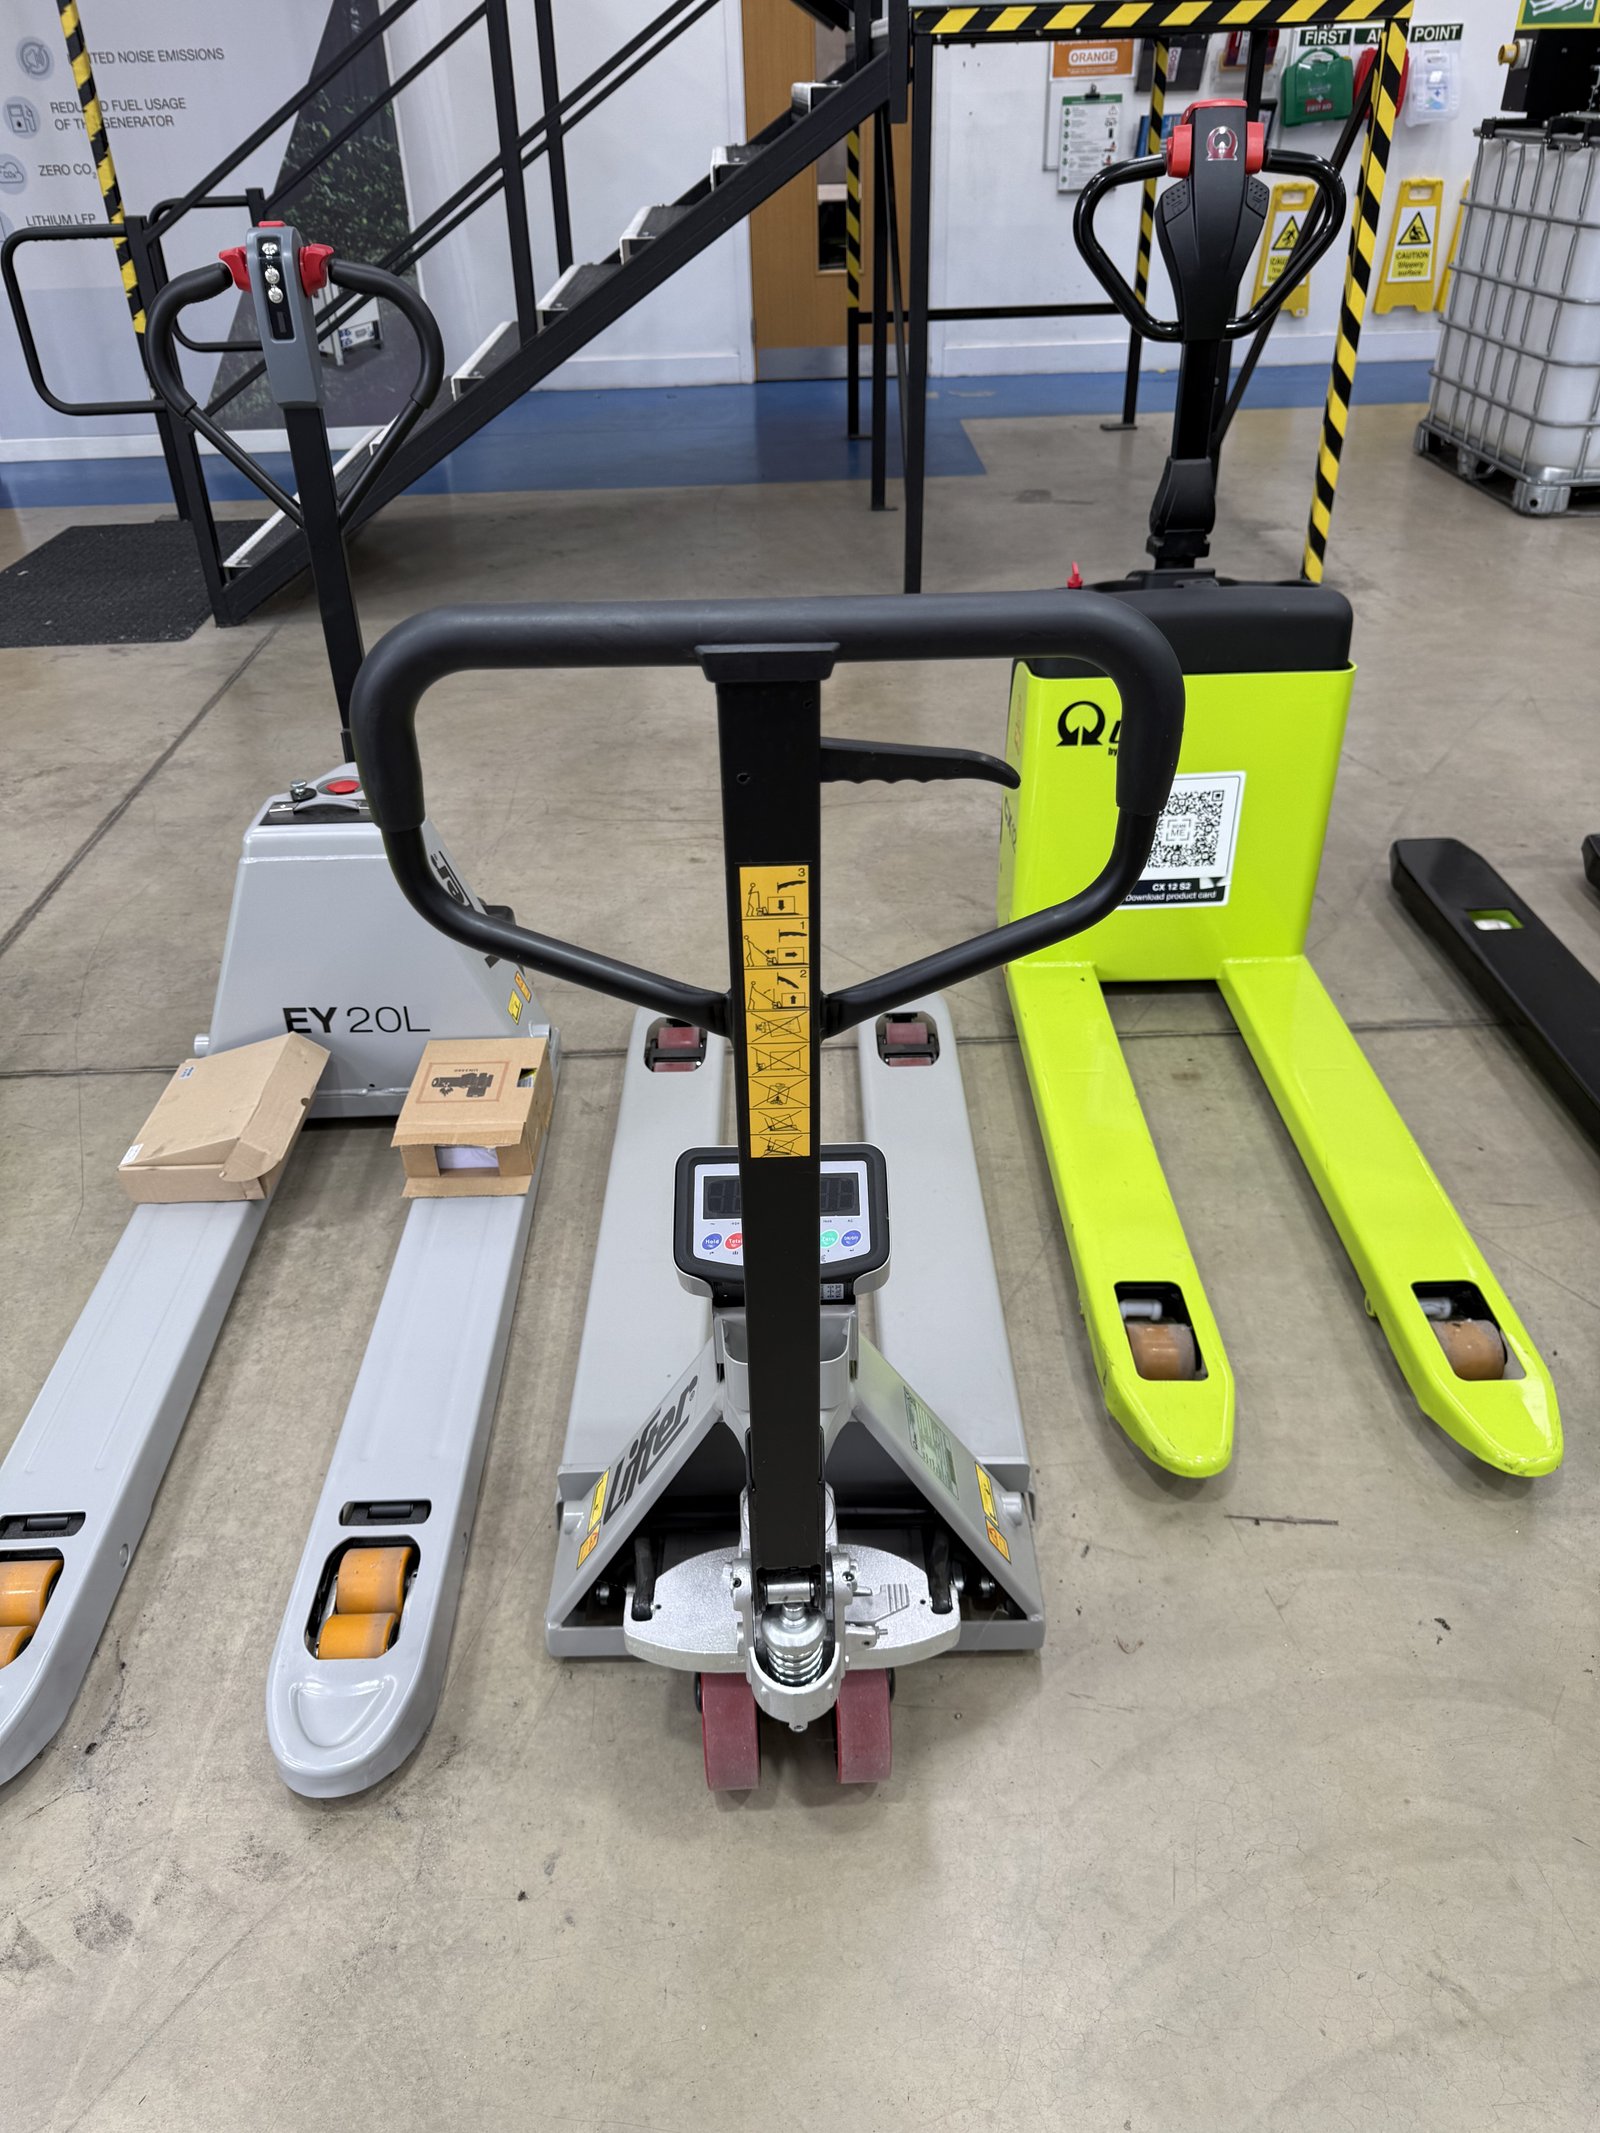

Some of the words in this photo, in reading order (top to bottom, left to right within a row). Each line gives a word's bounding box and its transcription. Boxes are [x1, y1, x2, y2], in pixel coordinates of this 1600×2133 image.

[1304, 29, 1347, 45] FIRST
[1366, 28, 1381, 43] AI
[1413, 25, 1460, 41] POINT
[117, 49, 155, 64] NOISE
[159, 47, 225, 62] EMISSIONS
[1070, 49, 1117, 63] ORANGE
[50, 100, 109, 114] REDUD
[112, 99, 143, 112] FUEL
[146, 97, 187, 110] USAGE
[54, 118, 71, 131] OF
[102, 115, 175, 129] GENERATOR
[38, 164, 71, 177] ZERO
[25, 213, 72, 226] LITHIUM
[1395, 250, 1429, 260] CAUTION
[1170, 829, 1186, 837] ME
[797, 867, 806, 877] 3
[1152, 882, 1166, 892] CX
[1167, 882, 1178, 891] 12
[1179, 881, 1192, 891] S2
[1125, 892, 1165, 902] Download
[1166, 891, 1196, 902] product
[1197, 890, 1217, 900] card
[800, 921, 805, 930] 1
[799, 969, 807, 979] 2
[282, 1006, 338, 1034] EY
[346, 1005, 431, 1033] 20L
[603, 1375, 699, 1525] Lifter
